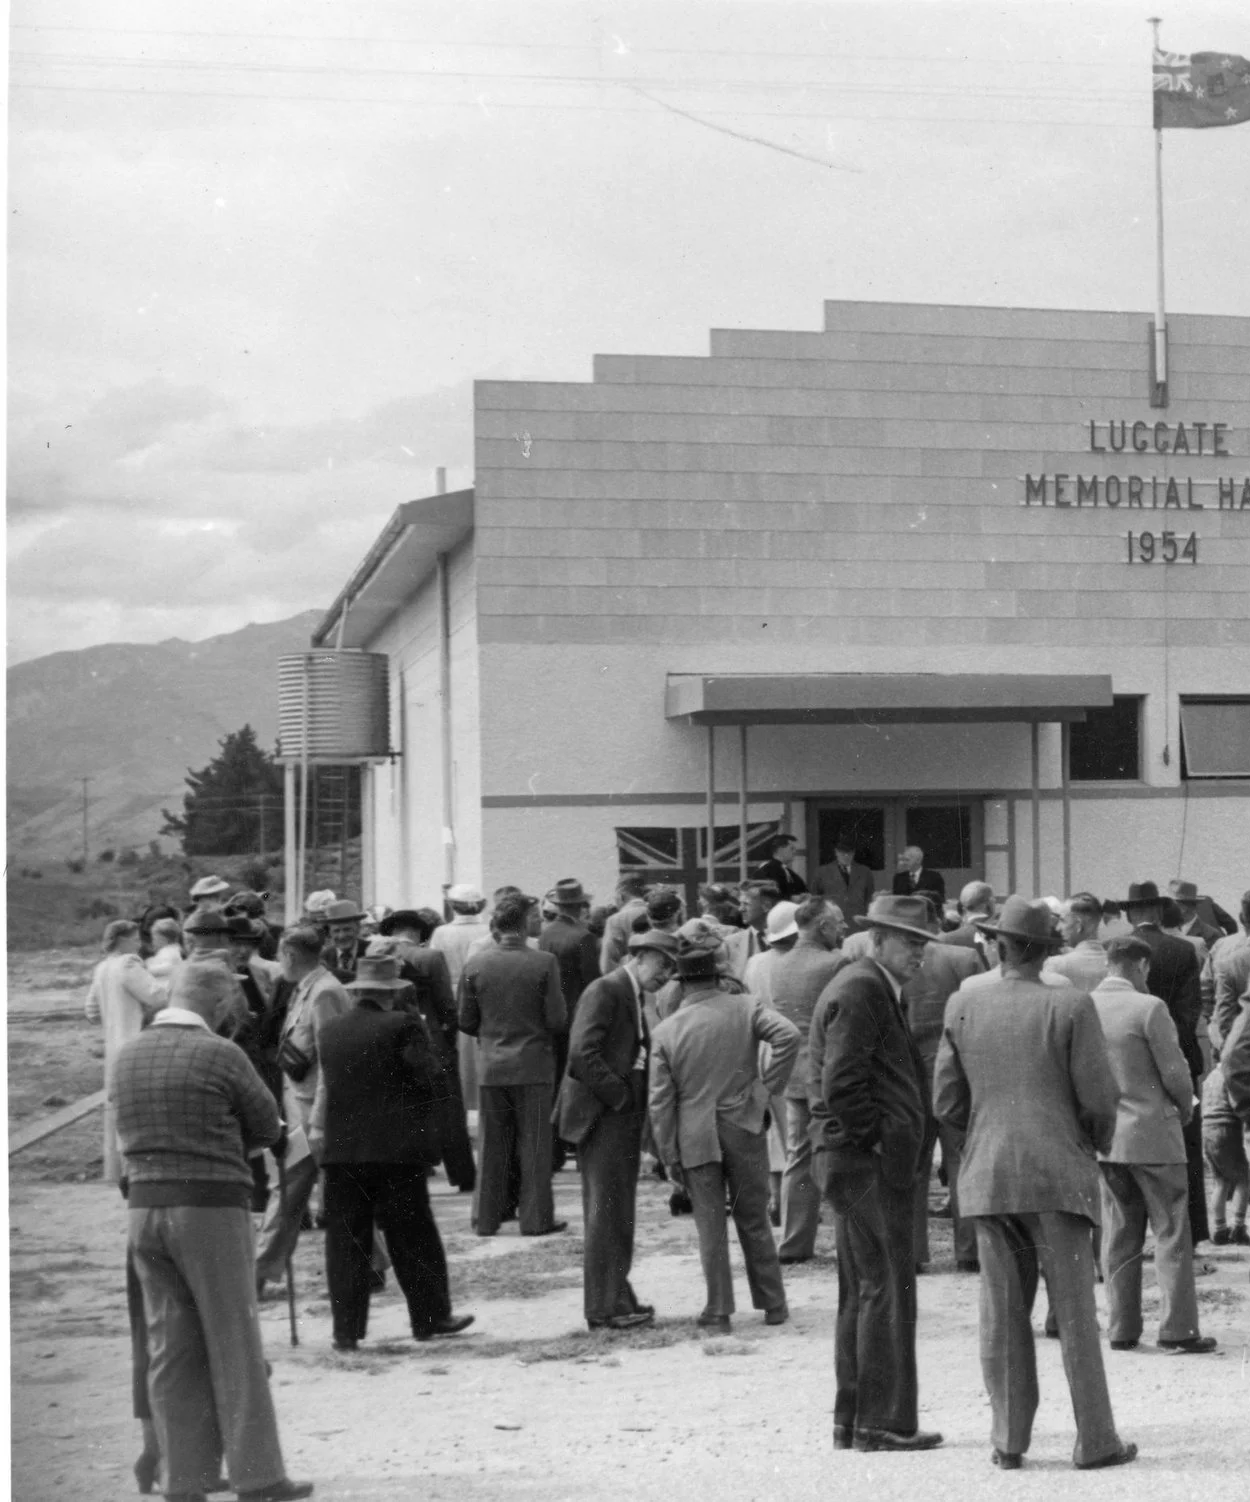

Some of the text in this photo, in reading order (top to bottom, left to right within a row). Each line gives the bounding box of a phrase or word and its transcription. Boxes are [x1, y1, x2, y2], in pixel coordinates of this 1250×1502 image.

[1090, 420, 1228, 455] LUGGATE
[1026, 474, 1203, 510] MEMORIAL
[1128, 530, 1197, 564] 1954
